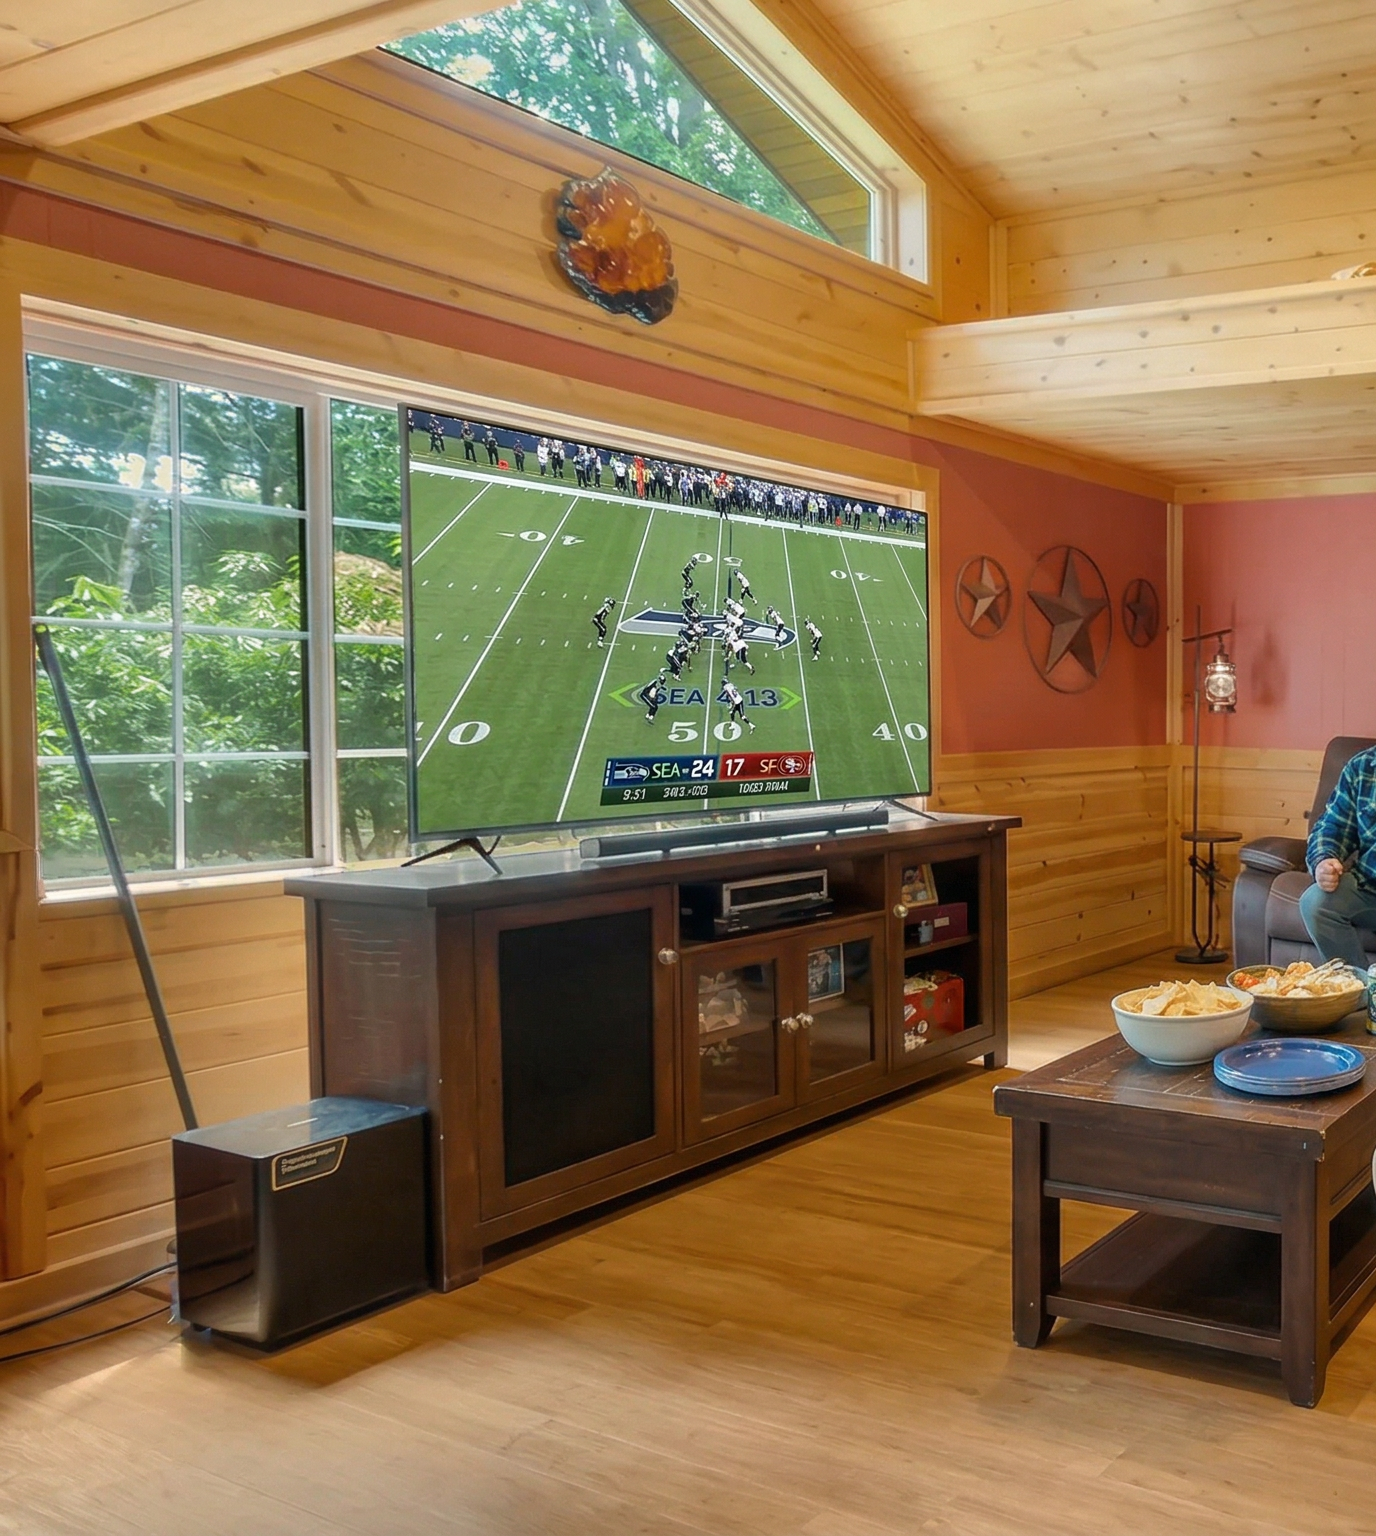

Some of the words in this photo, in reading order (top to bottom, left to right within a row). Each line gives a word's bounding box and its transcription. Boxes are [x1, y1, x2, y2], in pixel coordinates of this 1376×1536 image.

[667, 721, 743, 743] 50
[872, 722, 928, 741] 40
[651, 762, 681, 779] SEA
[691, 758, 715, 778] 24
[725, 758, 745, 777] 17
[759, 759, 778, 773] SF
